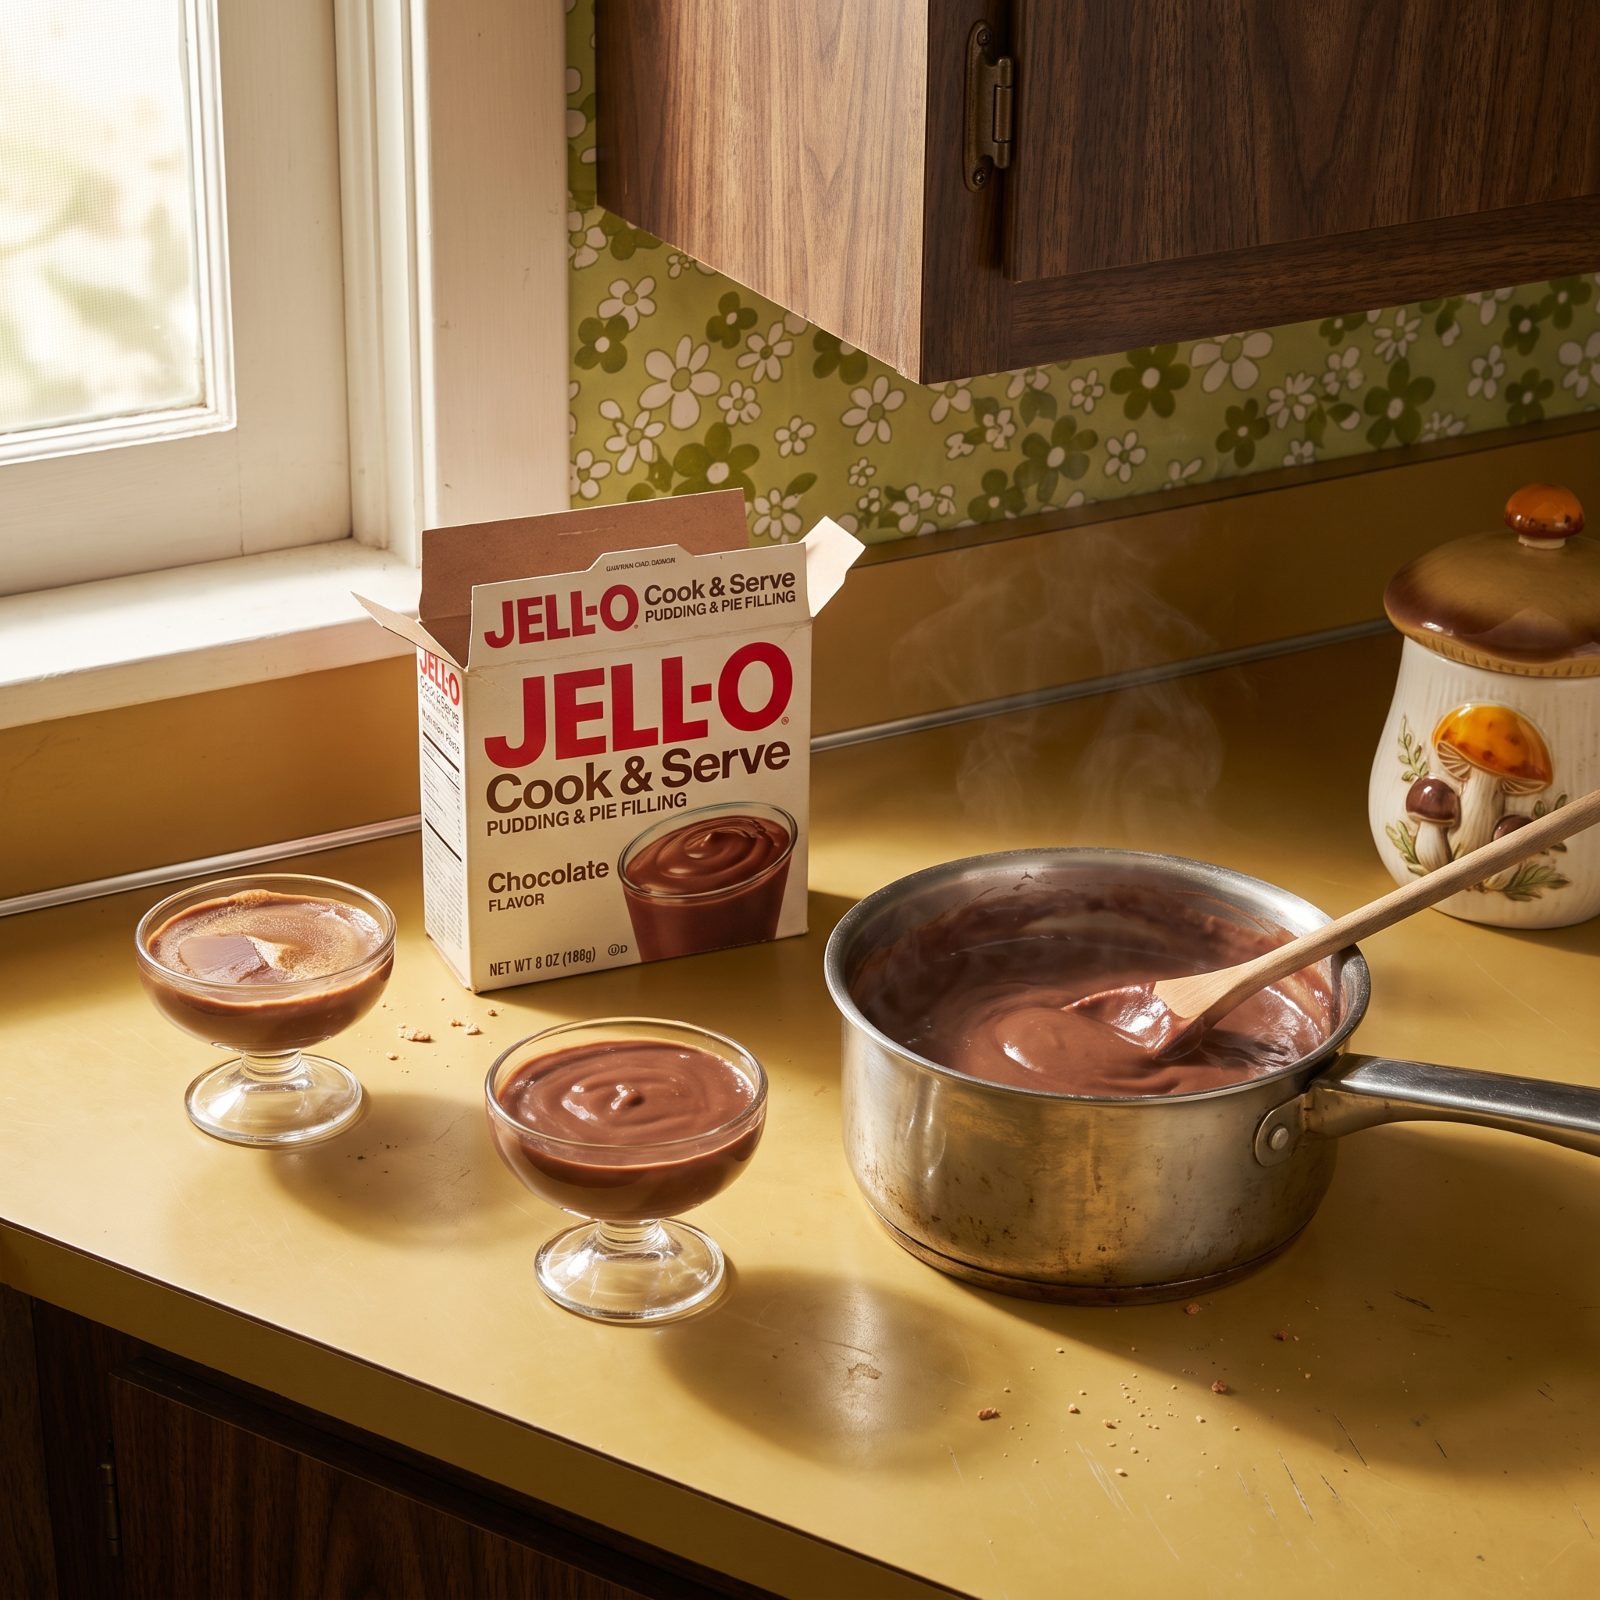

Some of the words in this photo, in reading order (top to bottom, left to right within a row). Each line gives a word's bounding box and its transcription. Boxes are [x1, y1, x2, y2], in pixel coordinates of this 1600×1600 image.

[644, 580, 705, 606] Cook
[709, 576, 726, 597] &
[730, 571, 796, 592] Serve
[645, 595, 706, 623] PUDDING
[709, 601, 720, 614] &
[721, 595, 742, 613] PIE
[745, 590, 796, 609] FILLING
[484, 584, 639, 649] JELL-O
[419, 650, 460, 706] JELL-O
[484, 642, 793, 769] JELL-O
[486, 761, 613, 813] Cook
[620, 755, 653, 795] &
[661, 741, 791, 788] Serve
[487, 810, 570, 836] PUDDING
[573, 810, 586, 825] &
[589, 802, 617, 822] PIE
[621, 792, 687, 817] FILLING
[488, 860, 609, 894] Chocolate
[488, 893, 545, 912] FLAVOR
[490, 961, 511, 977] NET
[514, 957, 532, 973] WT
[535, 956, 542, 970] 8
[545, 952, 560, 968] OZ
[562, 946, 596, 967] (188g)
